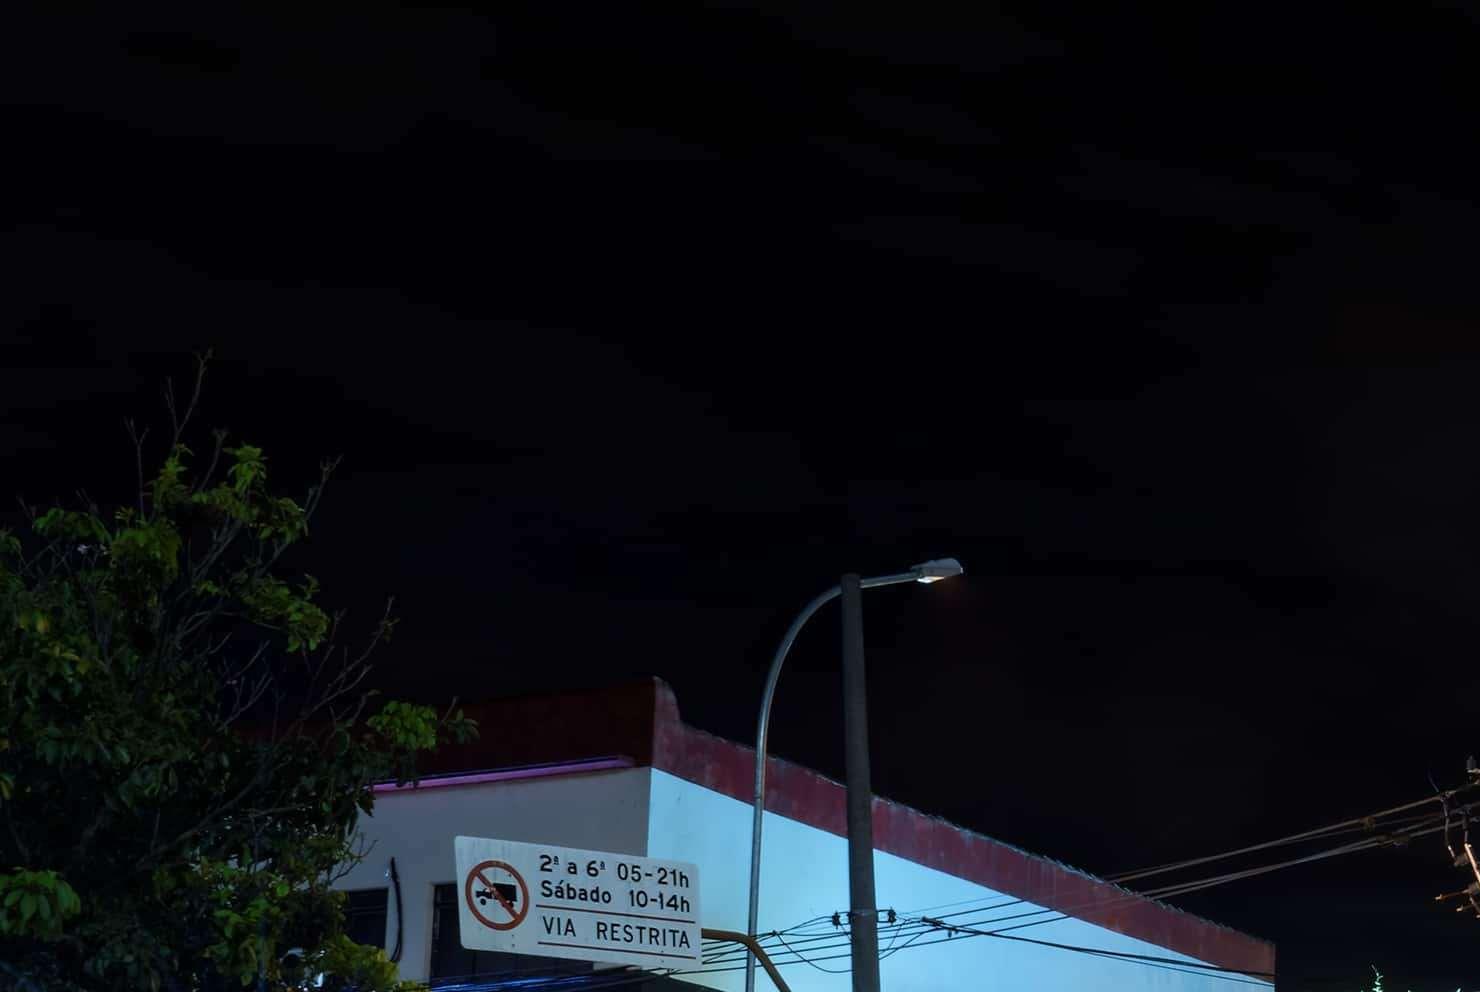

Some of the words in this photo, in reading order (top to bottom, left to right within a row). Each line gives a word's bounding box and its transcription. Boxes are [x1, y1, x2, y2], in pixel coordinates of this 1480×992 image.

[567, 861, 578, 875] a
[616, 863, 690, 889] 05-21h
[540, 879, 612, 905] Sábado
[629, 889, 691, 913] 10-14h
[542, 915, 576, 938] VIA
[597, 921, 691, 949] RESTRITA
